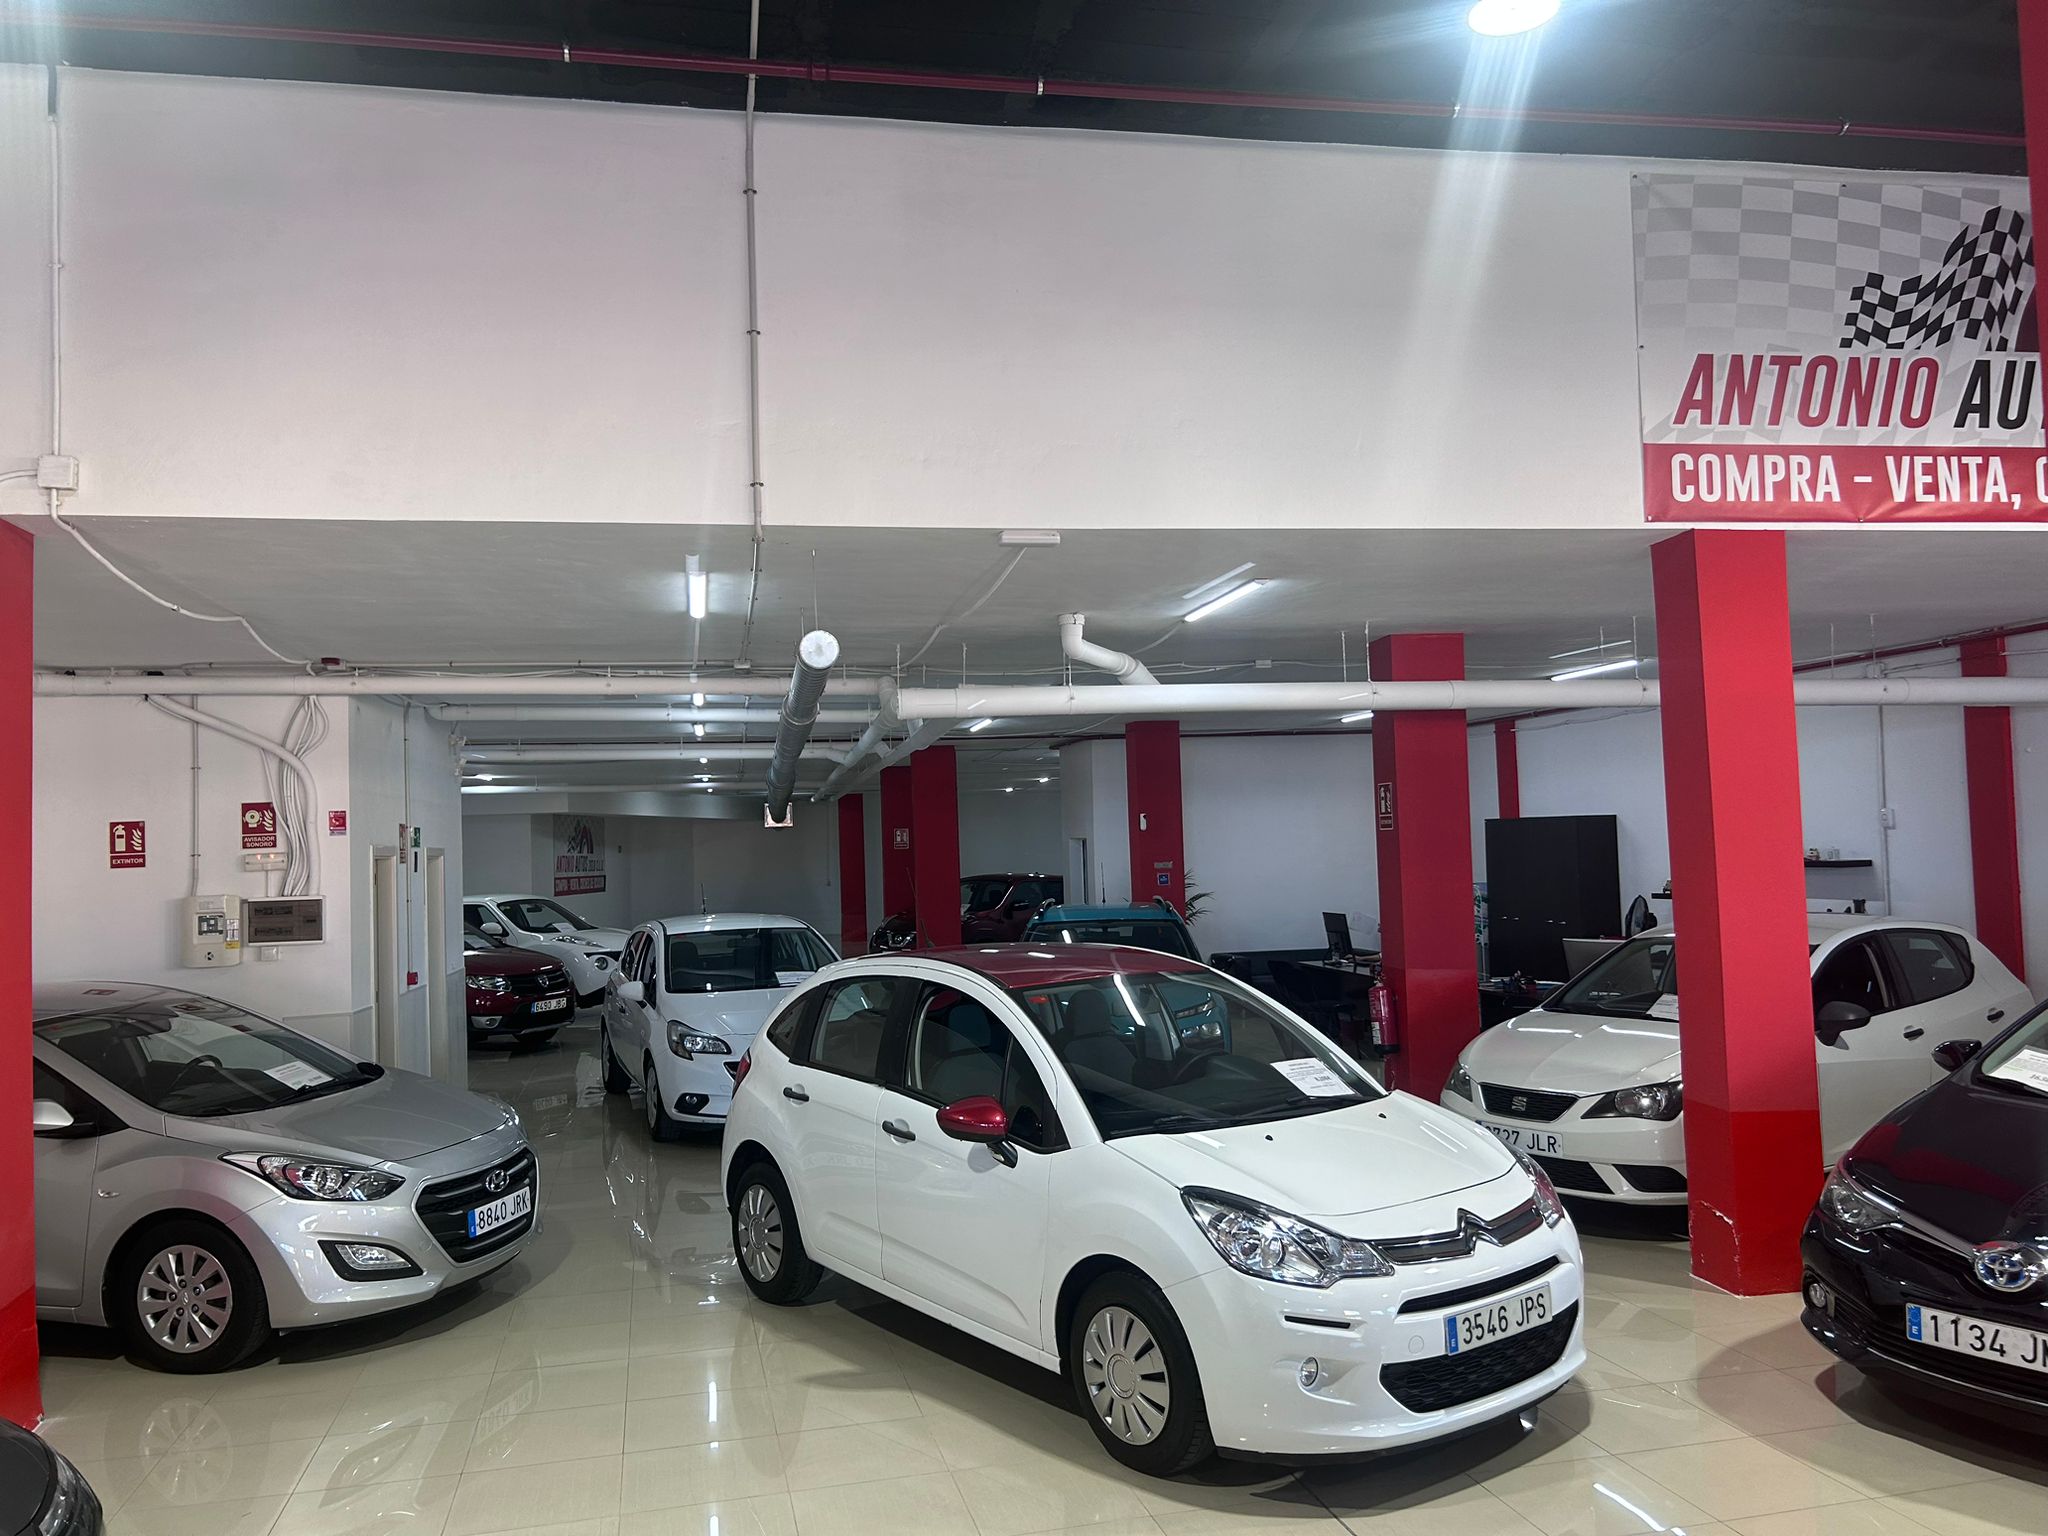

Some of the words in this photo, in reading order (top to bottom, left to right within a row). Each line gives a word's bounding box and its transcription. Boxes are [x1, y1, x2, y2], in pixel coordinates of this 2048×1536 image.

[1672, 353, 1940, 428] ANTONIO
[1953, 359, 2044, 430] AU
[1671, 453, 1841, 502] COMPRA
[1885, 455, 2021, 510] VENTA,
[1526, 1133, 1557, 1153] JLR
[479, 1202, 507, 1229] 8840
[511, 1191, 528, 1215] JRK
[1462, 1305, 1508, 1345] 3546
[1516, 1292, 1546, 1327] JPS
[1930, 1314, 2006, 1357] 1134
